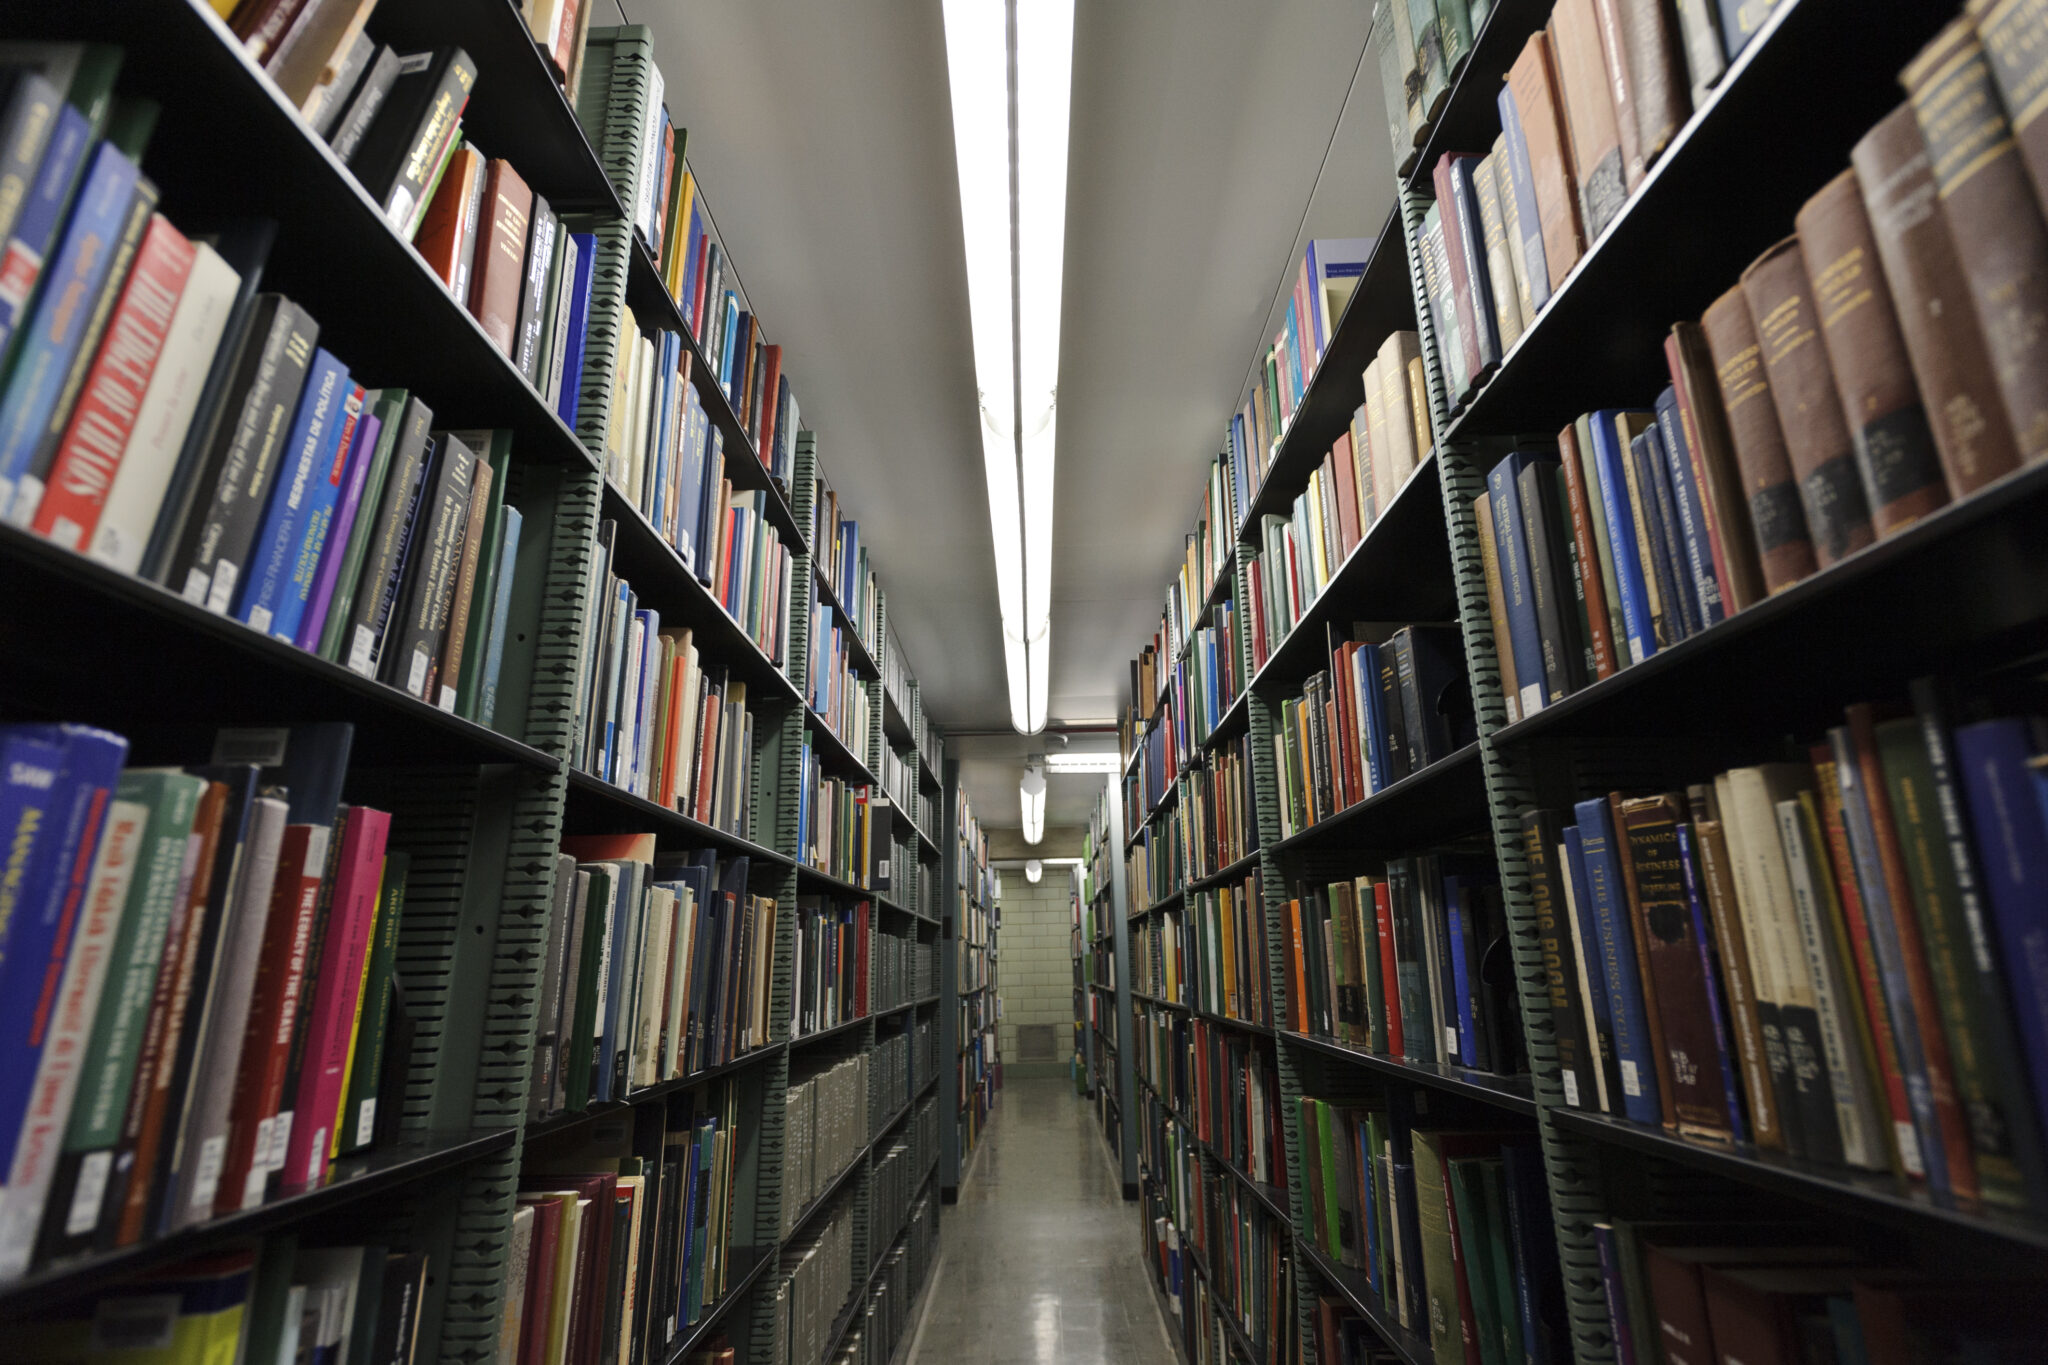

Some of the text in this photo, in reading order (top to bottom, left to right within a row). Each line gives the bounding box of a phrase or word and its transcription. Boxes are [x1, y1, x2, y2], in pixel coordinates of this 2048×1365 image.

[130, 269, 173, 324] THE
[107, 314, 157, 385] EDGE
[94, 376, 133, 421] OF
[69, 412, 120, 502] CHAOS
[288, 437, 316, 507] RESPUESTAS
[309, 418, 321, 436] DE
[315, 370, 335, 418] POLÍTICA
[400, 454, 414, 489] Financial
[1600, 478, 1610, 499] THE
[434, 506, 451, 546] Emerging
[1604, 499, 1614, 523] RISK
[388, 524, 407, 580] DOLLAR
[429, 547, 442, 579] Market
[429, 502, 461, 630] Economic and Financial Crises
[1500, 494, 1510, 533] POLITICAL
[1511, 574, 1521, 605] CYCLES
[1572, 561, 1580, 578] TRADE
[1611, 540, 1628, 597] ECONOMIC
[374, 585, 391, 635] CRISIS
[419, 581, 437, 628] Economies
[451, 538, 478, 672] THE GODS THAT FAILED
[1575, 579, 1583, 600] CYCLES
[1622, 599, 1635, 635] CRISIS
[384, 888, 397, 947] AND RISK
[1526, 824, 1567, 1006] THE LONG BOOM
[277, 887, 315, 1043] THE LEGACY OF THE CRASH
[1593, 864, 1628, 1052] THE BUSINESS CYCLE
